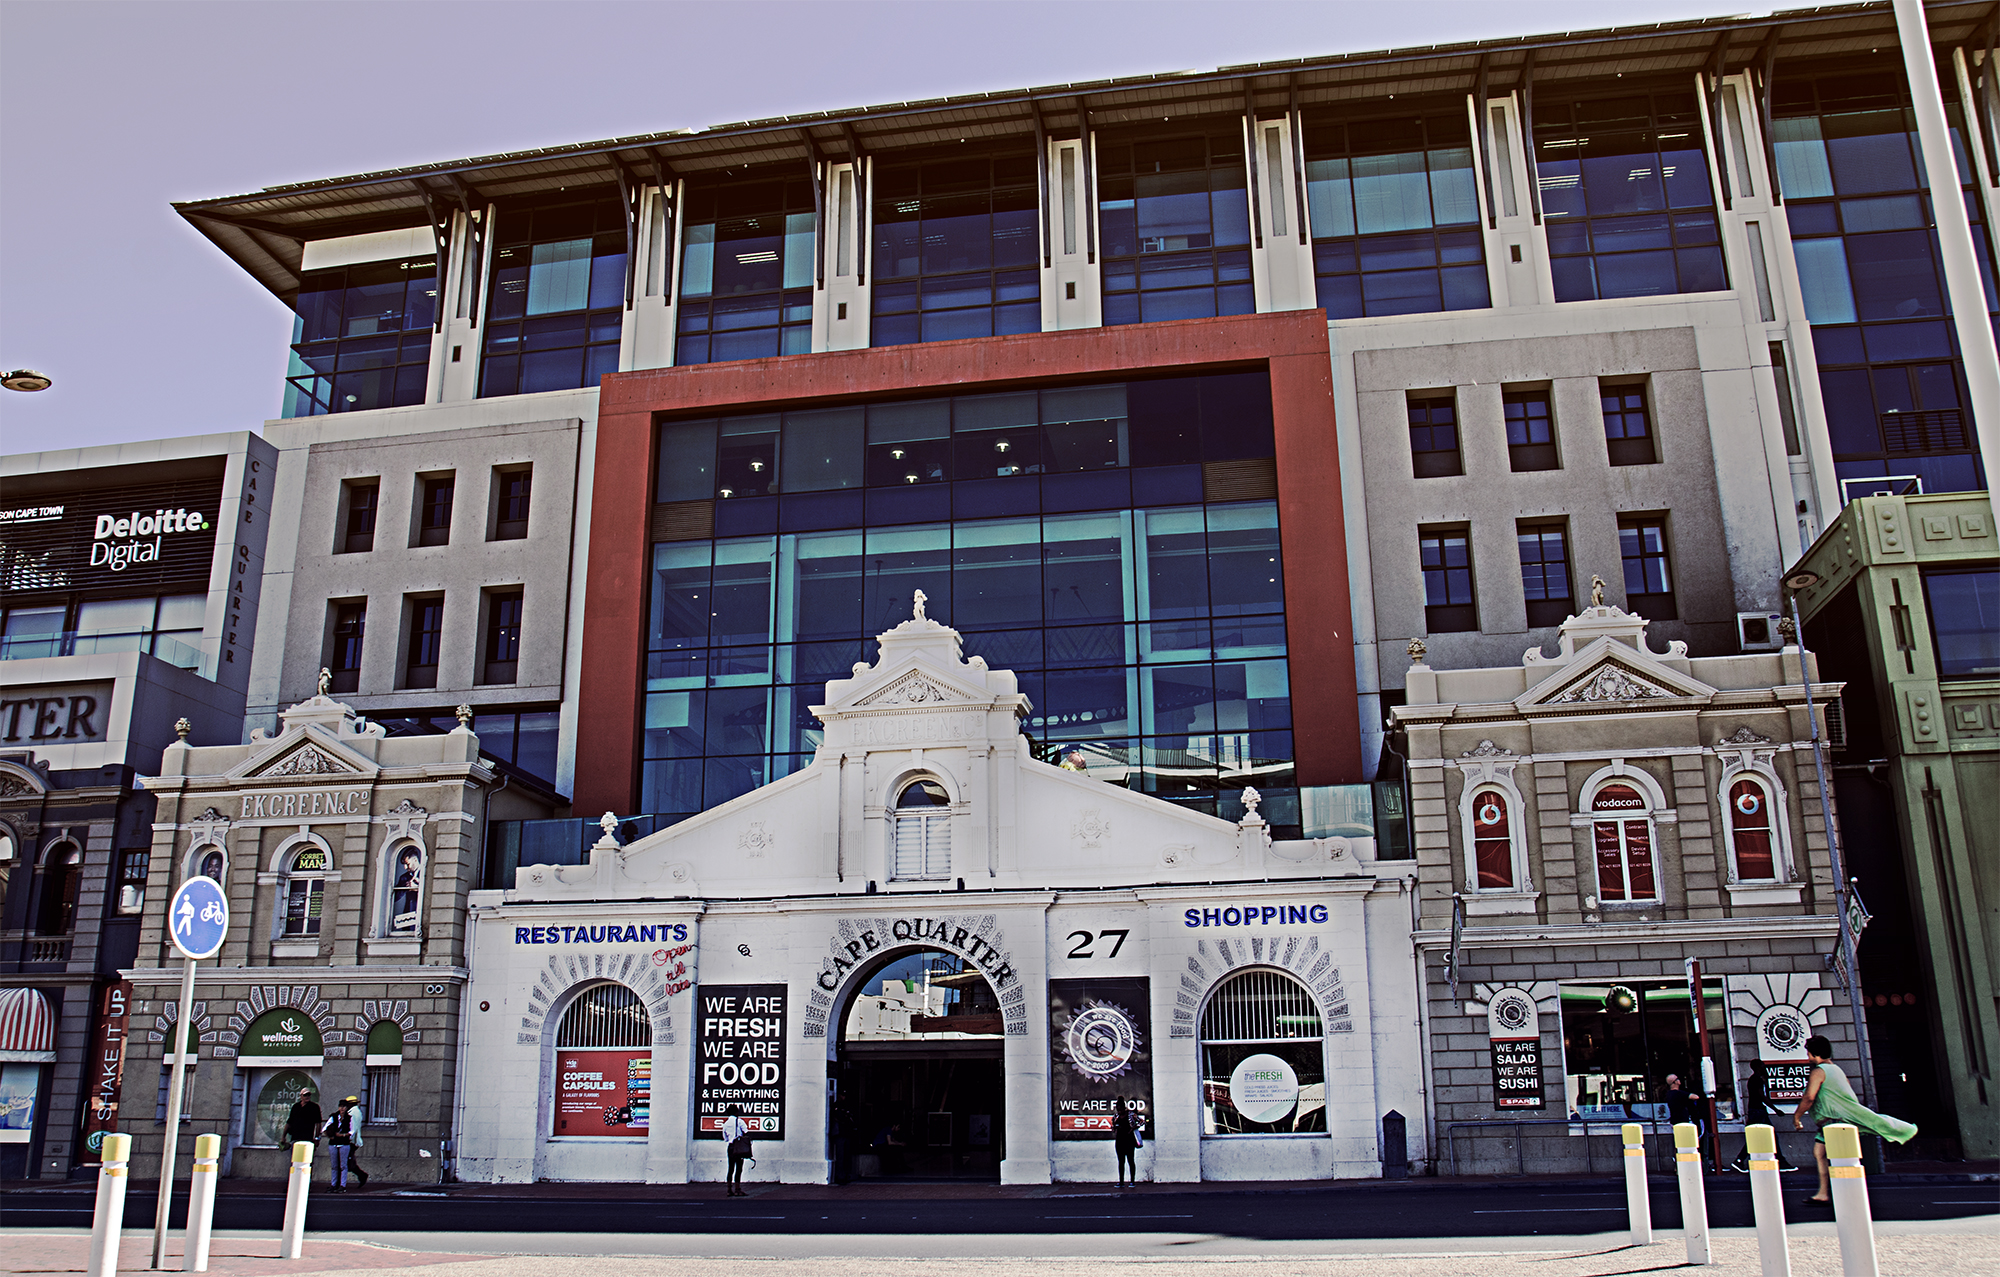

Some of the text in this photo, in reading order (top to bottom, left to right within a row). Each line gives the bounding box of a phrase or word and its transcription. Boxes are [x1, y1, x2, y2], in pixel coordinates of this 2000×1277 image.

[15, 508, 38, 519] CAPE
[39, 505, 64, 517] TOWN
[90, 536, 162, 571] Digital
[226, 460, 260, 663] CAPE QUARTER
[1596, 799, 1642, 808] vodacom
[299, 859, 324, 869] MAN
[1184, 904, 1329, 928] SHOPPING
[515, 923, 688, 944] RESTAURANTS
[1066, 929, 1130, 960] 27
[652, 944, 692, 966] Open
[819, 918, 1013, 992] CAPE QUARTER
[705, 997, 782, 1014] WE ARE
[704, 1018, 780, 1037] FRESH
[262, 1032, 303, 1042] wellness
[703, 1041, 780, 1058] WE ARE
[1495, 1043, 1535, 1052] WE ARE
[97, 989, 126, 1121] SHAKE IT UP
[1497, 1054, 1536, 1065] SALAD
[703, 1062, 780, 1085] FOOD
[1497, 1066, 1537, 1075] WE ARE
[1766, 1066, 1810, 1076] WE ARE
[563, 1072, 603, 1081] COFFEE
[562, 1081, 616, 1090] CAPSULES
[1499, 1078, 1538, 1089] SUSHI
[702, 1089, 779, 1099] & EVERYTHING
[701, 1102, 714, 1113] IN
[1060, 1100, 1146, 1111] WE ARE FOD
[713, 1119, 759, 1129] SR
